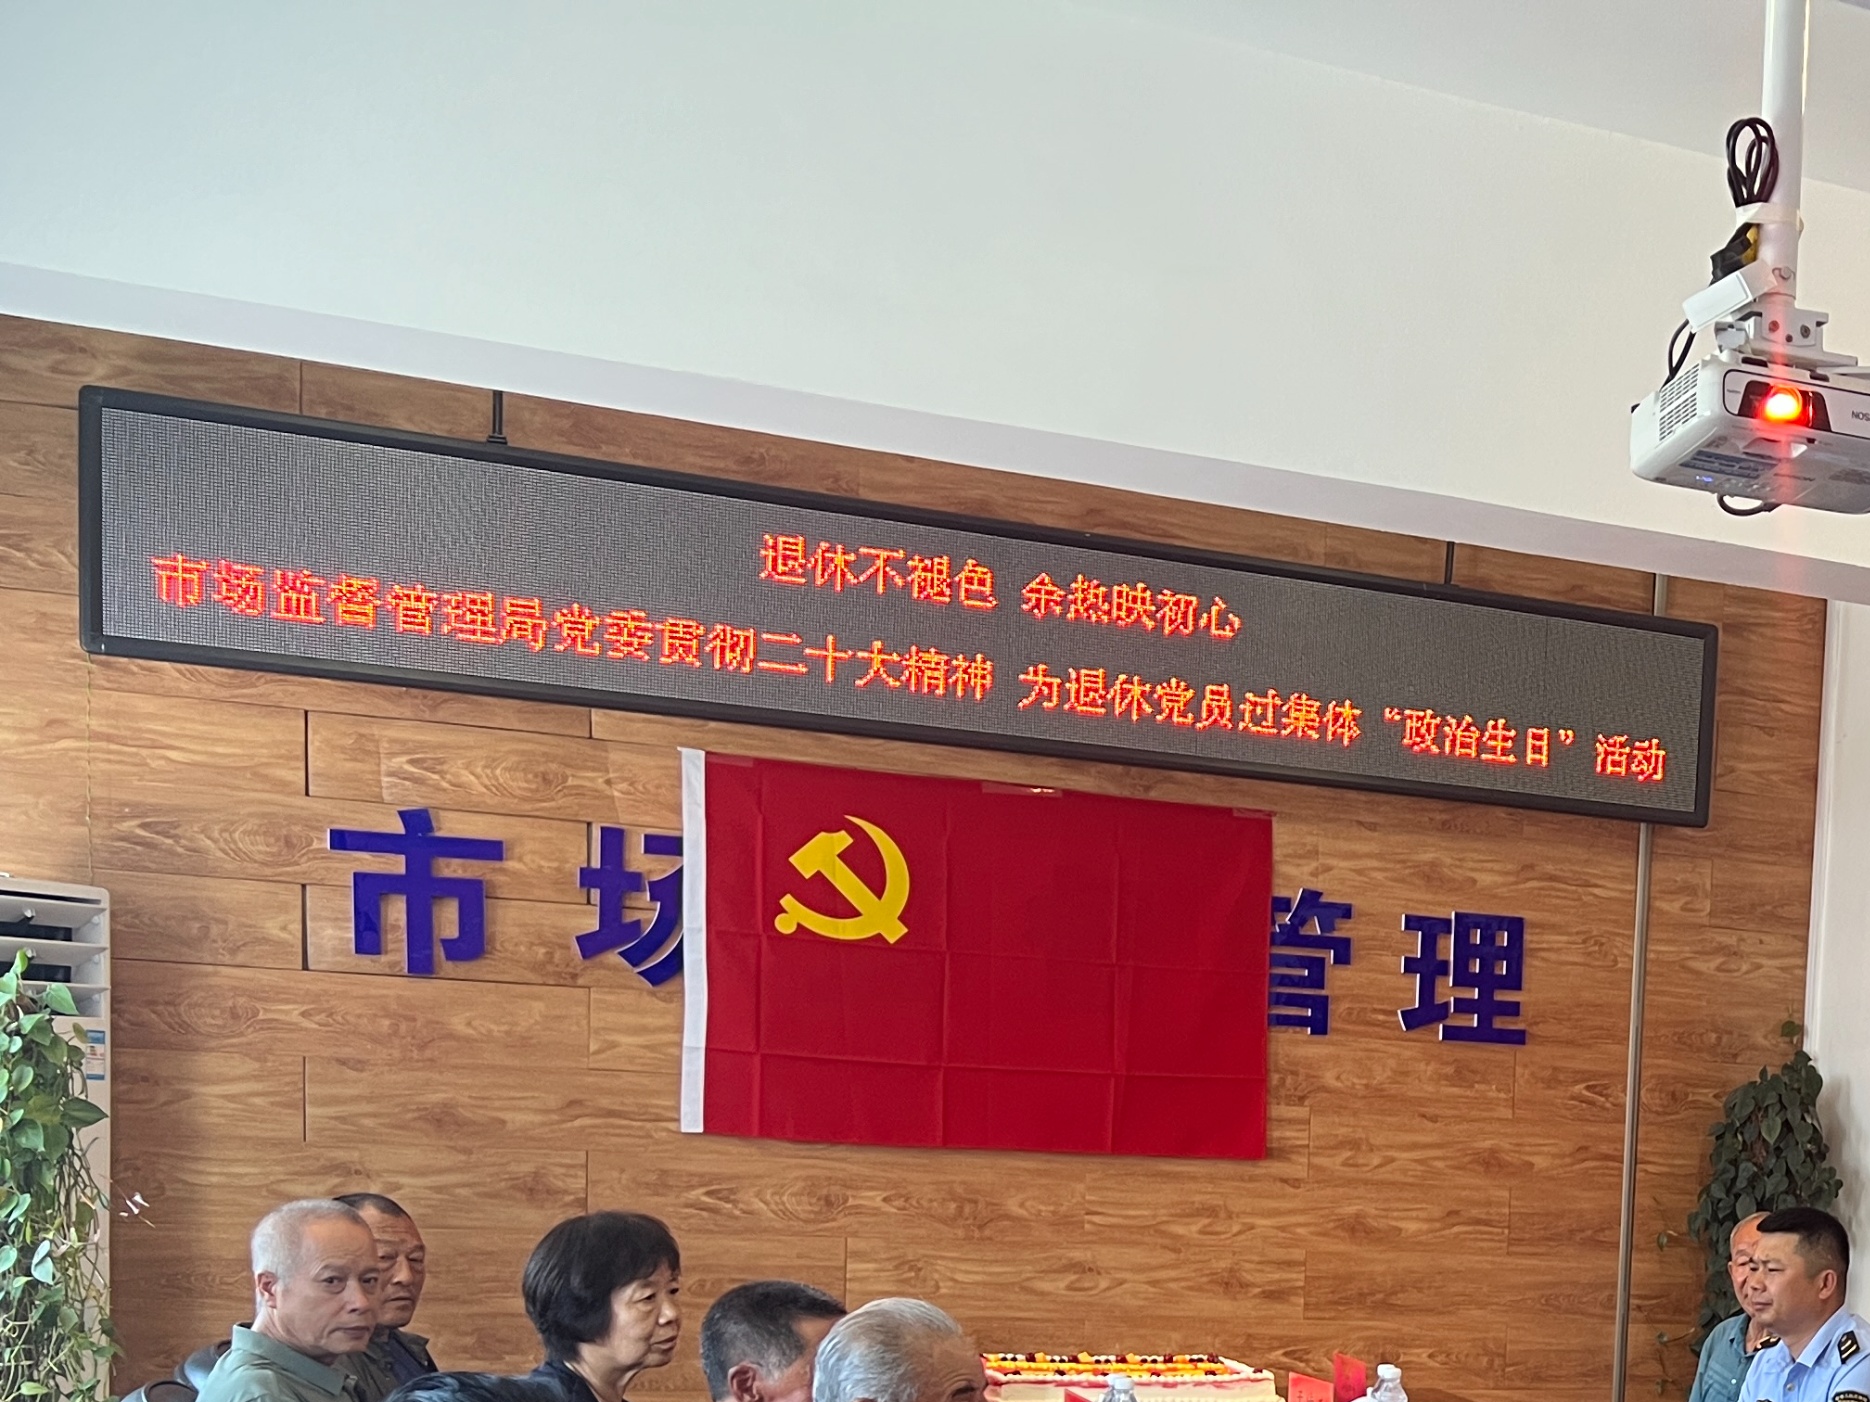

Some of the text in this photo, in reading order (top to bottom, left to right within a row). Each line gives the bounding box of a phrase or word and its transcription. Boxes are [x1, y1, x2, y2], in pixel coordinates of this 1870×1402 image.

[151, 552, 994, 703] 市场监督管理局党委贯彻二十大精神
[759, 533, 1243, 641] 退休不褪色 余热映初心
